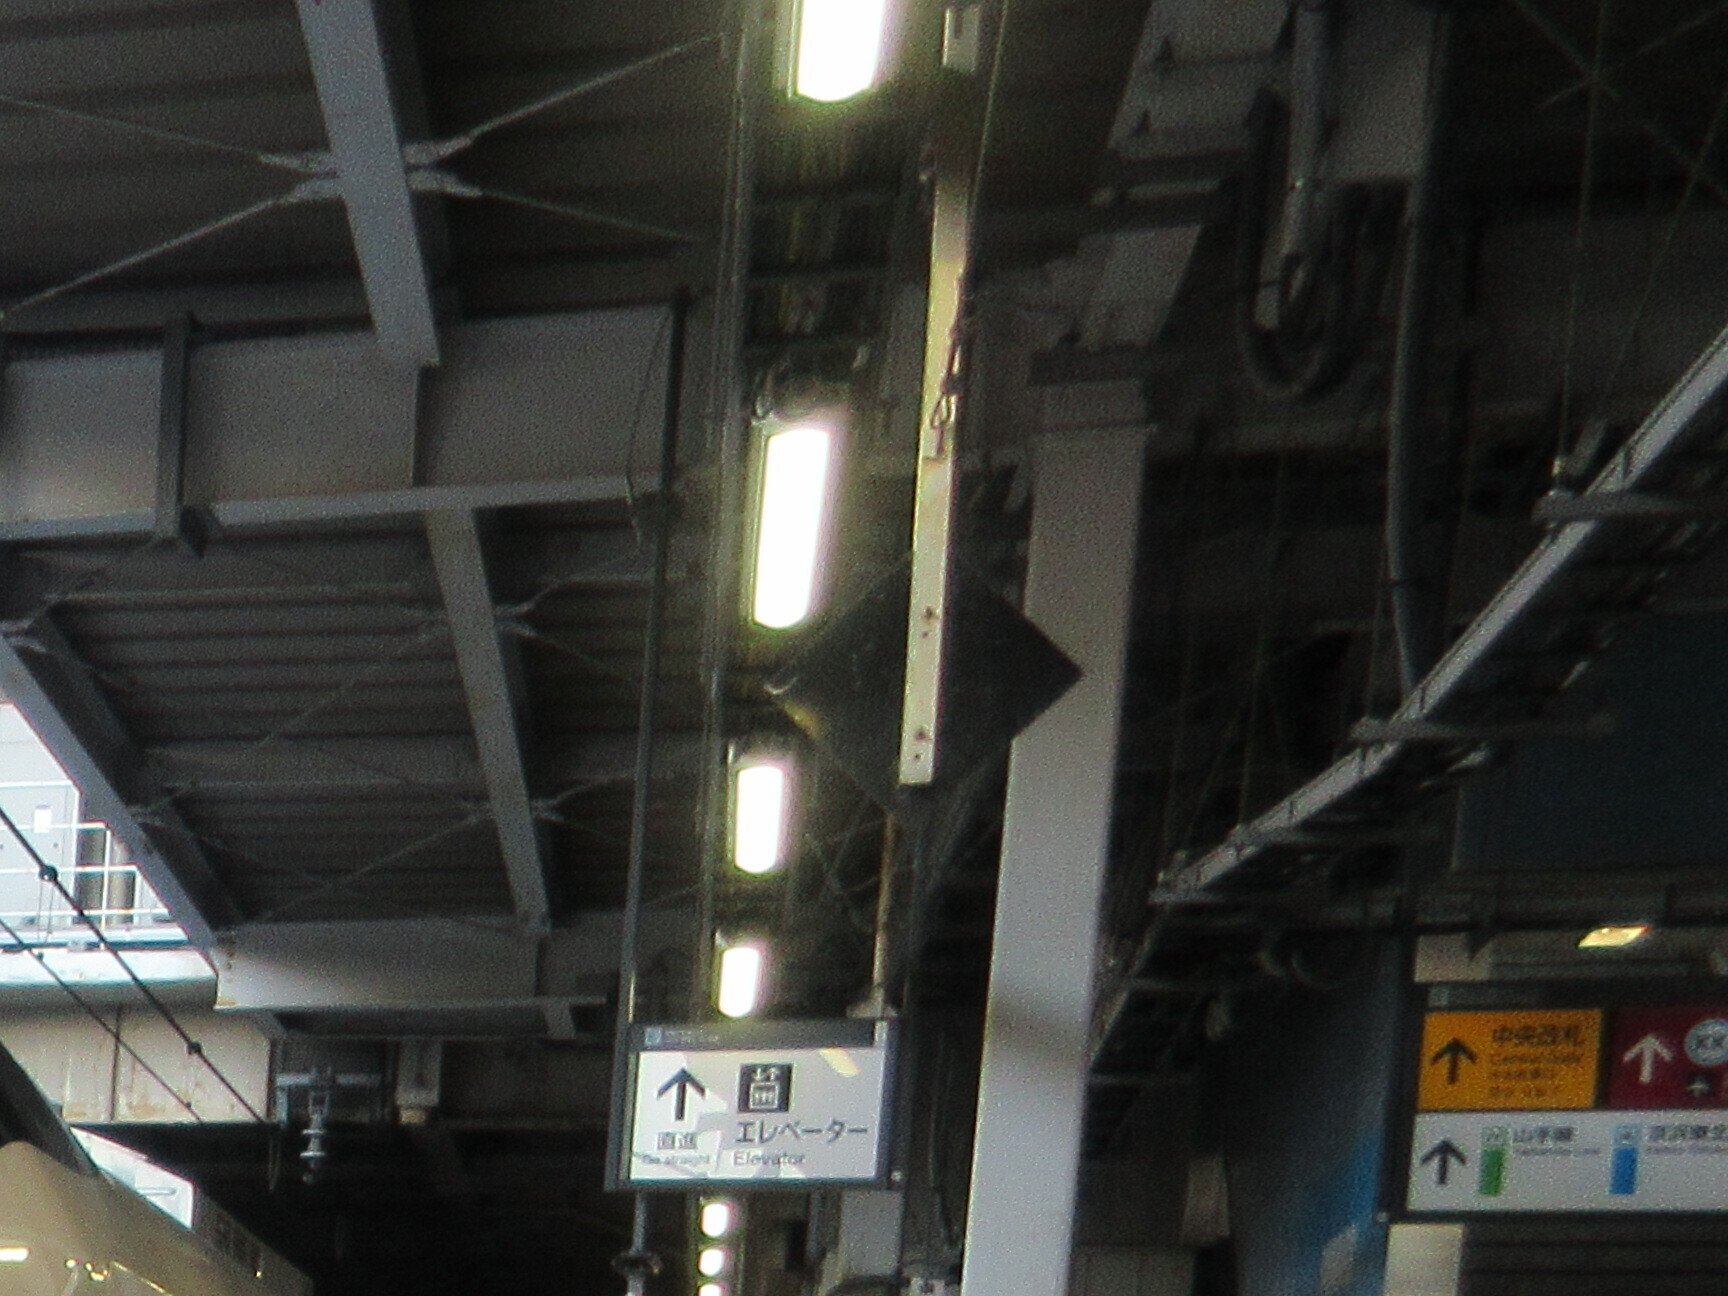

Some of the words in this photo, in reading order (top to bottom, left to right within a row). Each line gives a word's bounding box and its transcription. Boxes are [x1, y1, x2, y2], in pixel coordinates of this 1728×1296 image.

[734, 1118, 868, 1145] エレベーター
[732, 1151, 806, 1167] Elevator
